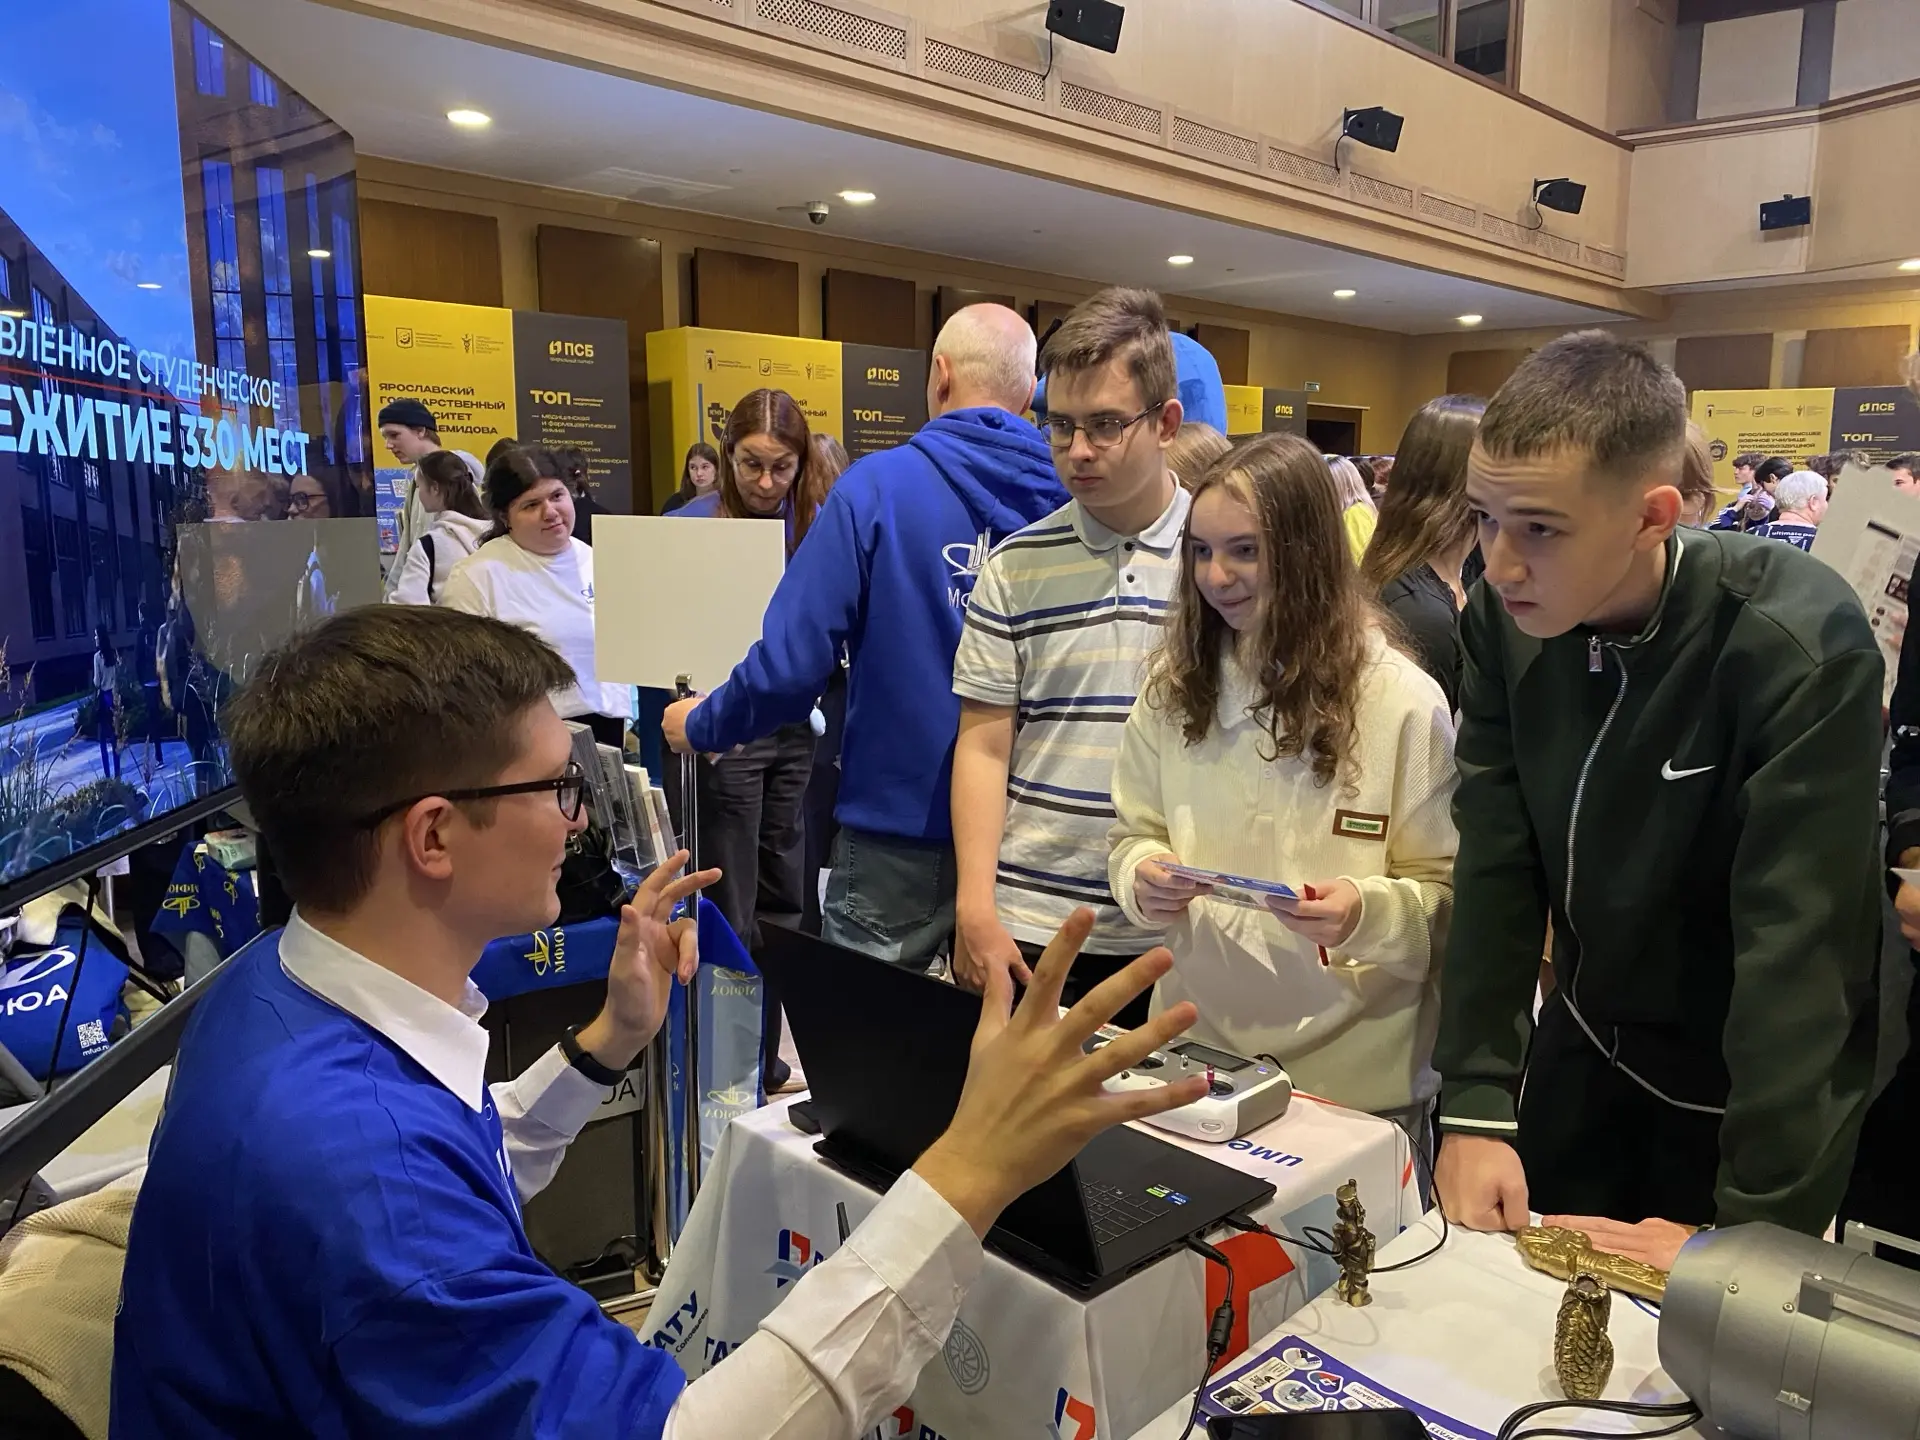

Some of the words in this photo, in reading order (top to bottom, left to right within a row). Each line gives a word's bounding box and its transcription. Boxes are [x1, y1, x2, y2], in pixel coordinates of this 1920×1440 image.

[564, 342, 594, 358] ПСБ
[137, 350, 281, 410] СТУДЕНЧЕСКОЕ
[878, 368, 900, 381] ПСБ
[379, 383, 475, 396] ЯРОСЛАВСКИЙ
[380, 396, 506, 410] ГОАРСТВЕННЫЙ
[530, 389, 571, 406] ТОП
[1871, 402, 1896, 412] ПСБ
[853, 409, 882, 422] ТОП
[0, 384, 175, 466] ЕЖИТИЕ
[180, 414, 235, 471] 330
[242, 424, 310, 476] МЕСТ
[1841, 433, 1873, 442] ТОП
[0, 984, 69, 1016] ЮА
